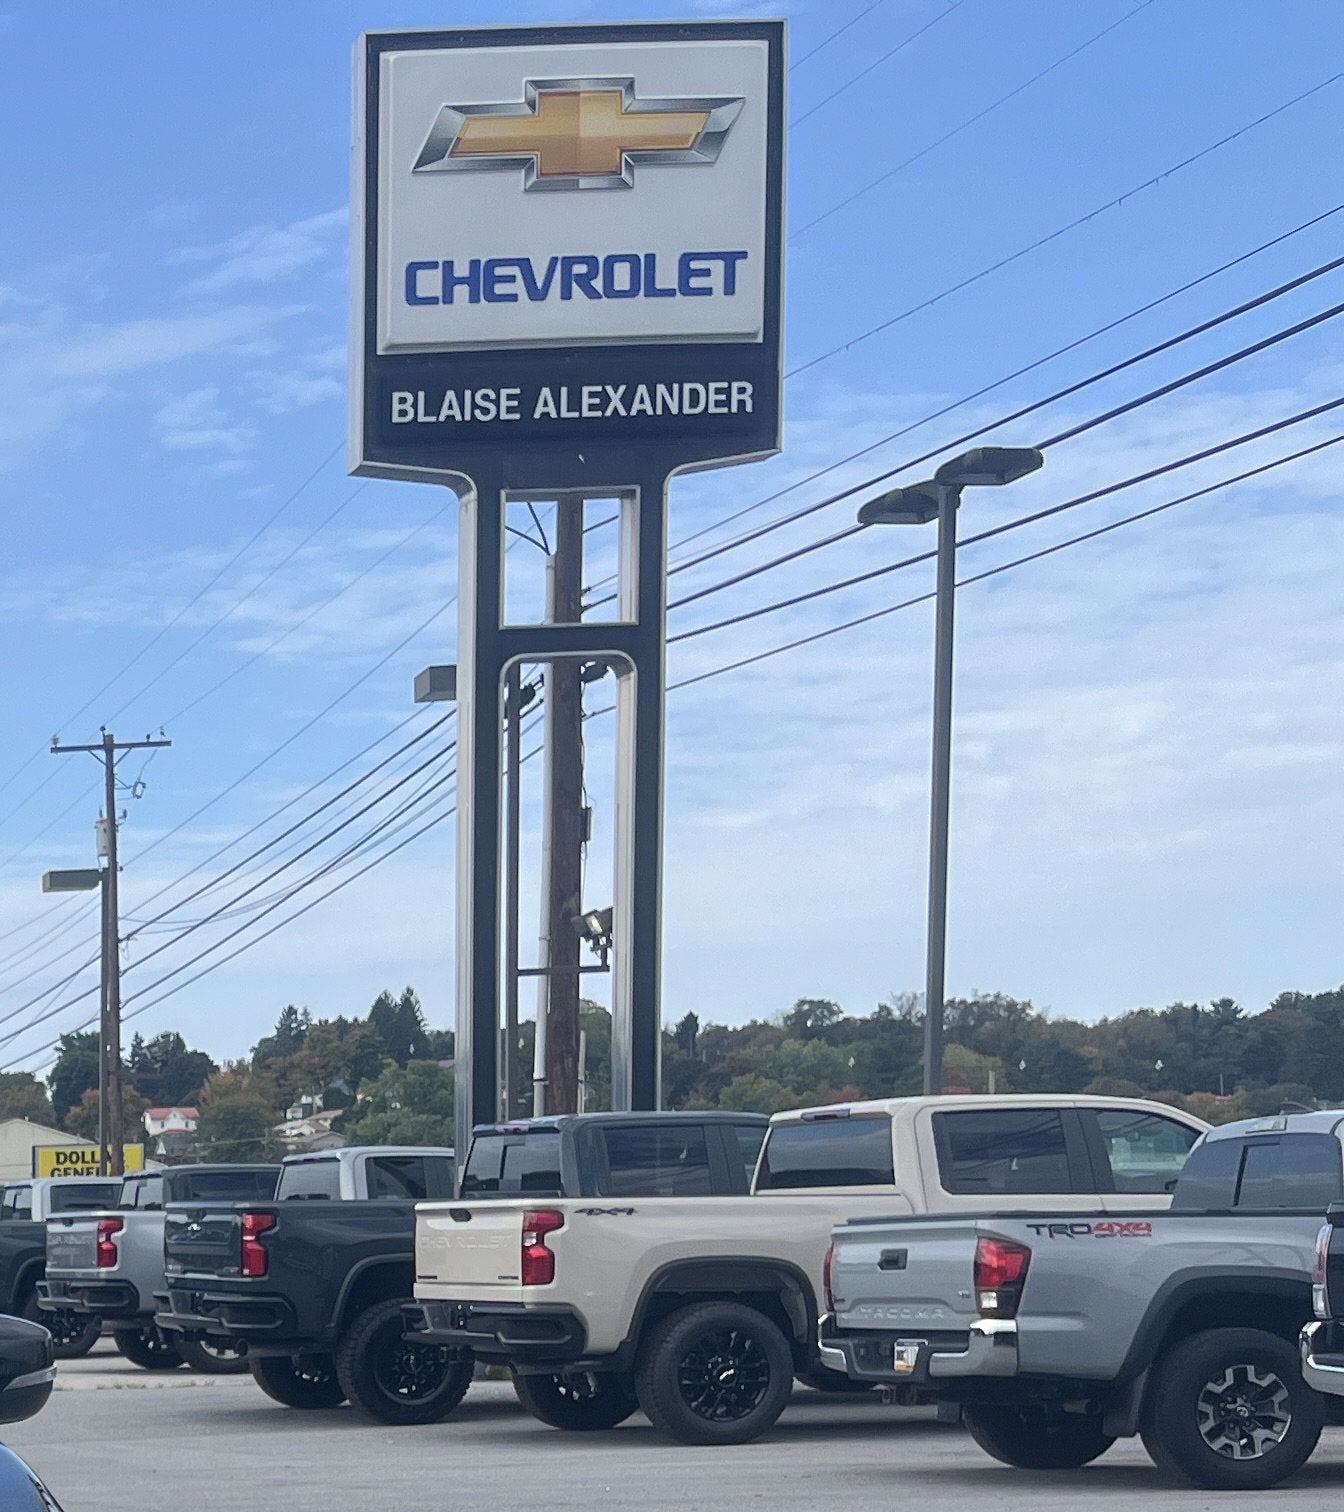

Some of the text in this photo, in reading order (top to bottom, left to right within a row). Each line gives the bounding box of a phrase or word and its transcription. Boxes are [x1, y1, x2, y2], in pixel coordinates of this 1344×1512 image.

[405, 251, 748, 306] CHEVROLET
[391, 381, 753, 423] BLAISE ALEXANDER
[55, 1150, 112, 1165] DOLL
[1026, 1223, 1091, 1239] TRD
[860, 1307, 945, 1320] TACOMA
